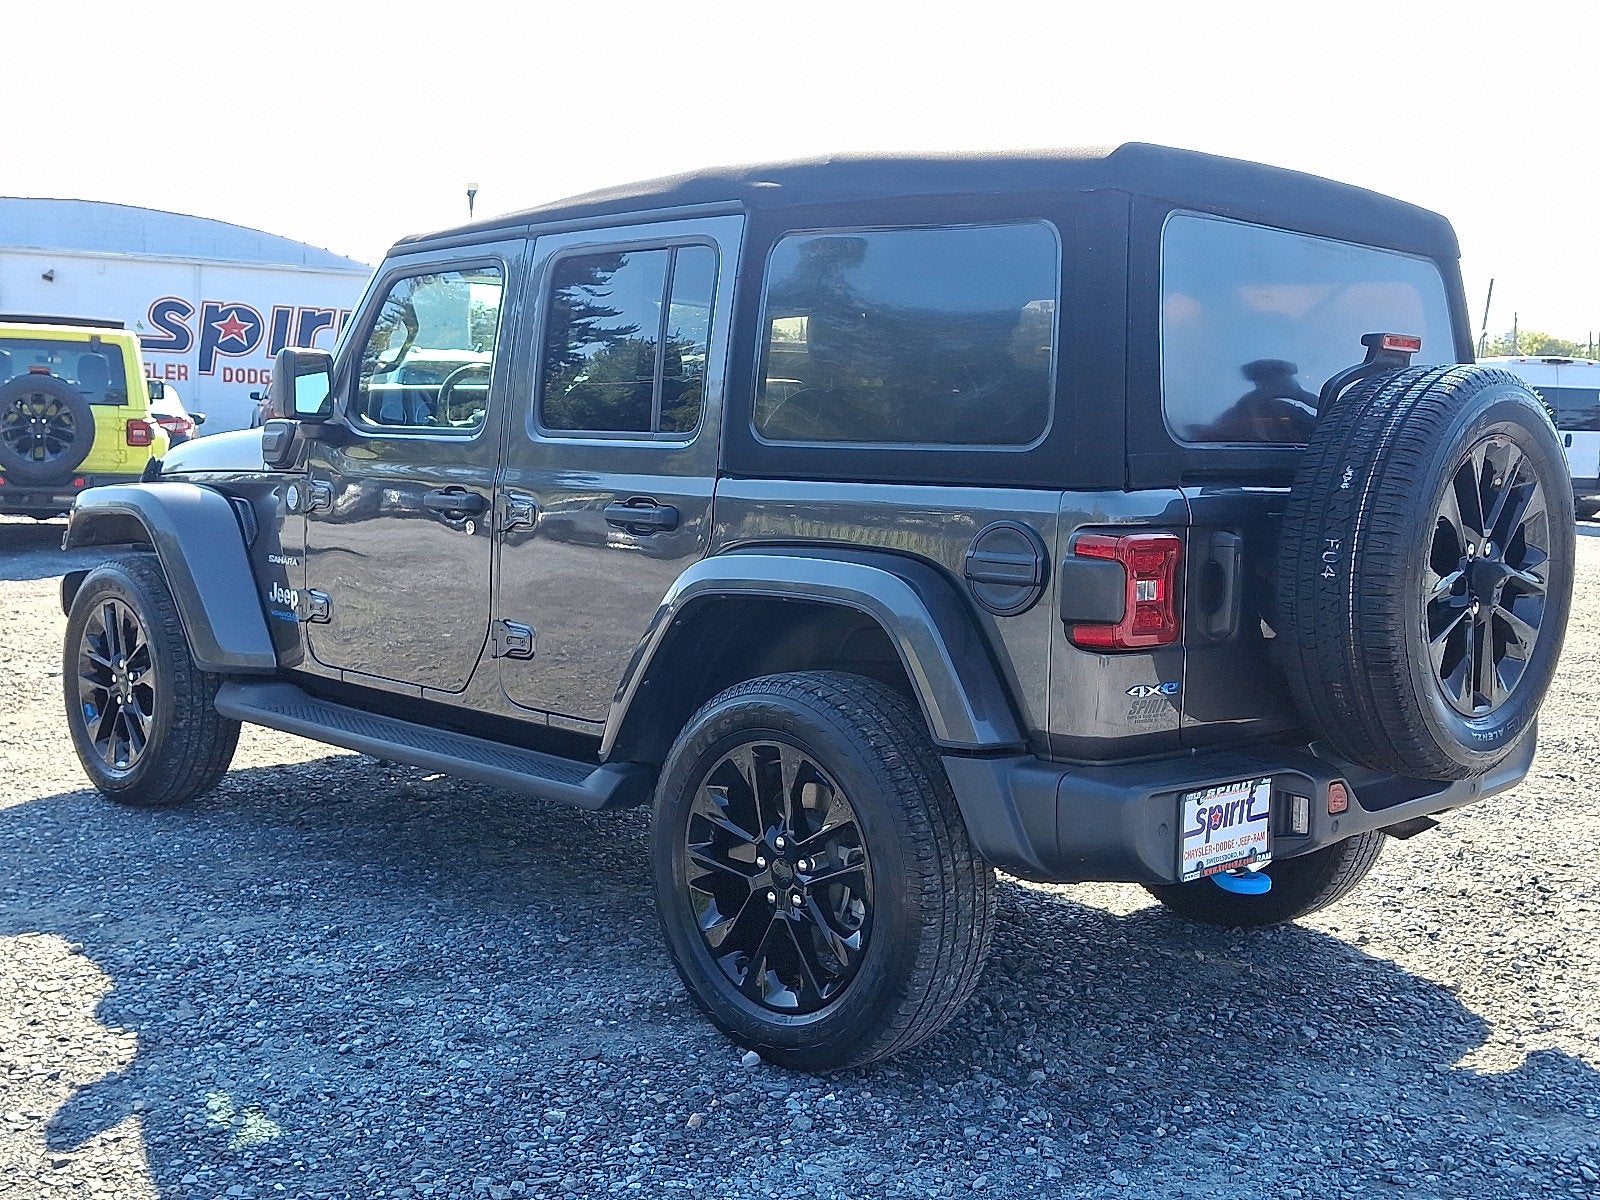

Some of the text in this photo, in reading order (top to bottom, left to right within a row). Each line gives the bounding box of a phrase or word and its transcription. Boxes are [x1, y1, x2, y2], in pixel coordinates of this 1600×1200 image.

[141, 296, 352, 376] spir
[144, 362, 272, 385] SLER DODG
[268, 554, 299, 567] SAHARA
[268, 581, 299, 611] Jeep
[1470, 727, 1504, 742] ALENZA
[1206, 780, 1254, 797] SPIRIT
[1215, 839, 1236, 853] DODGE
